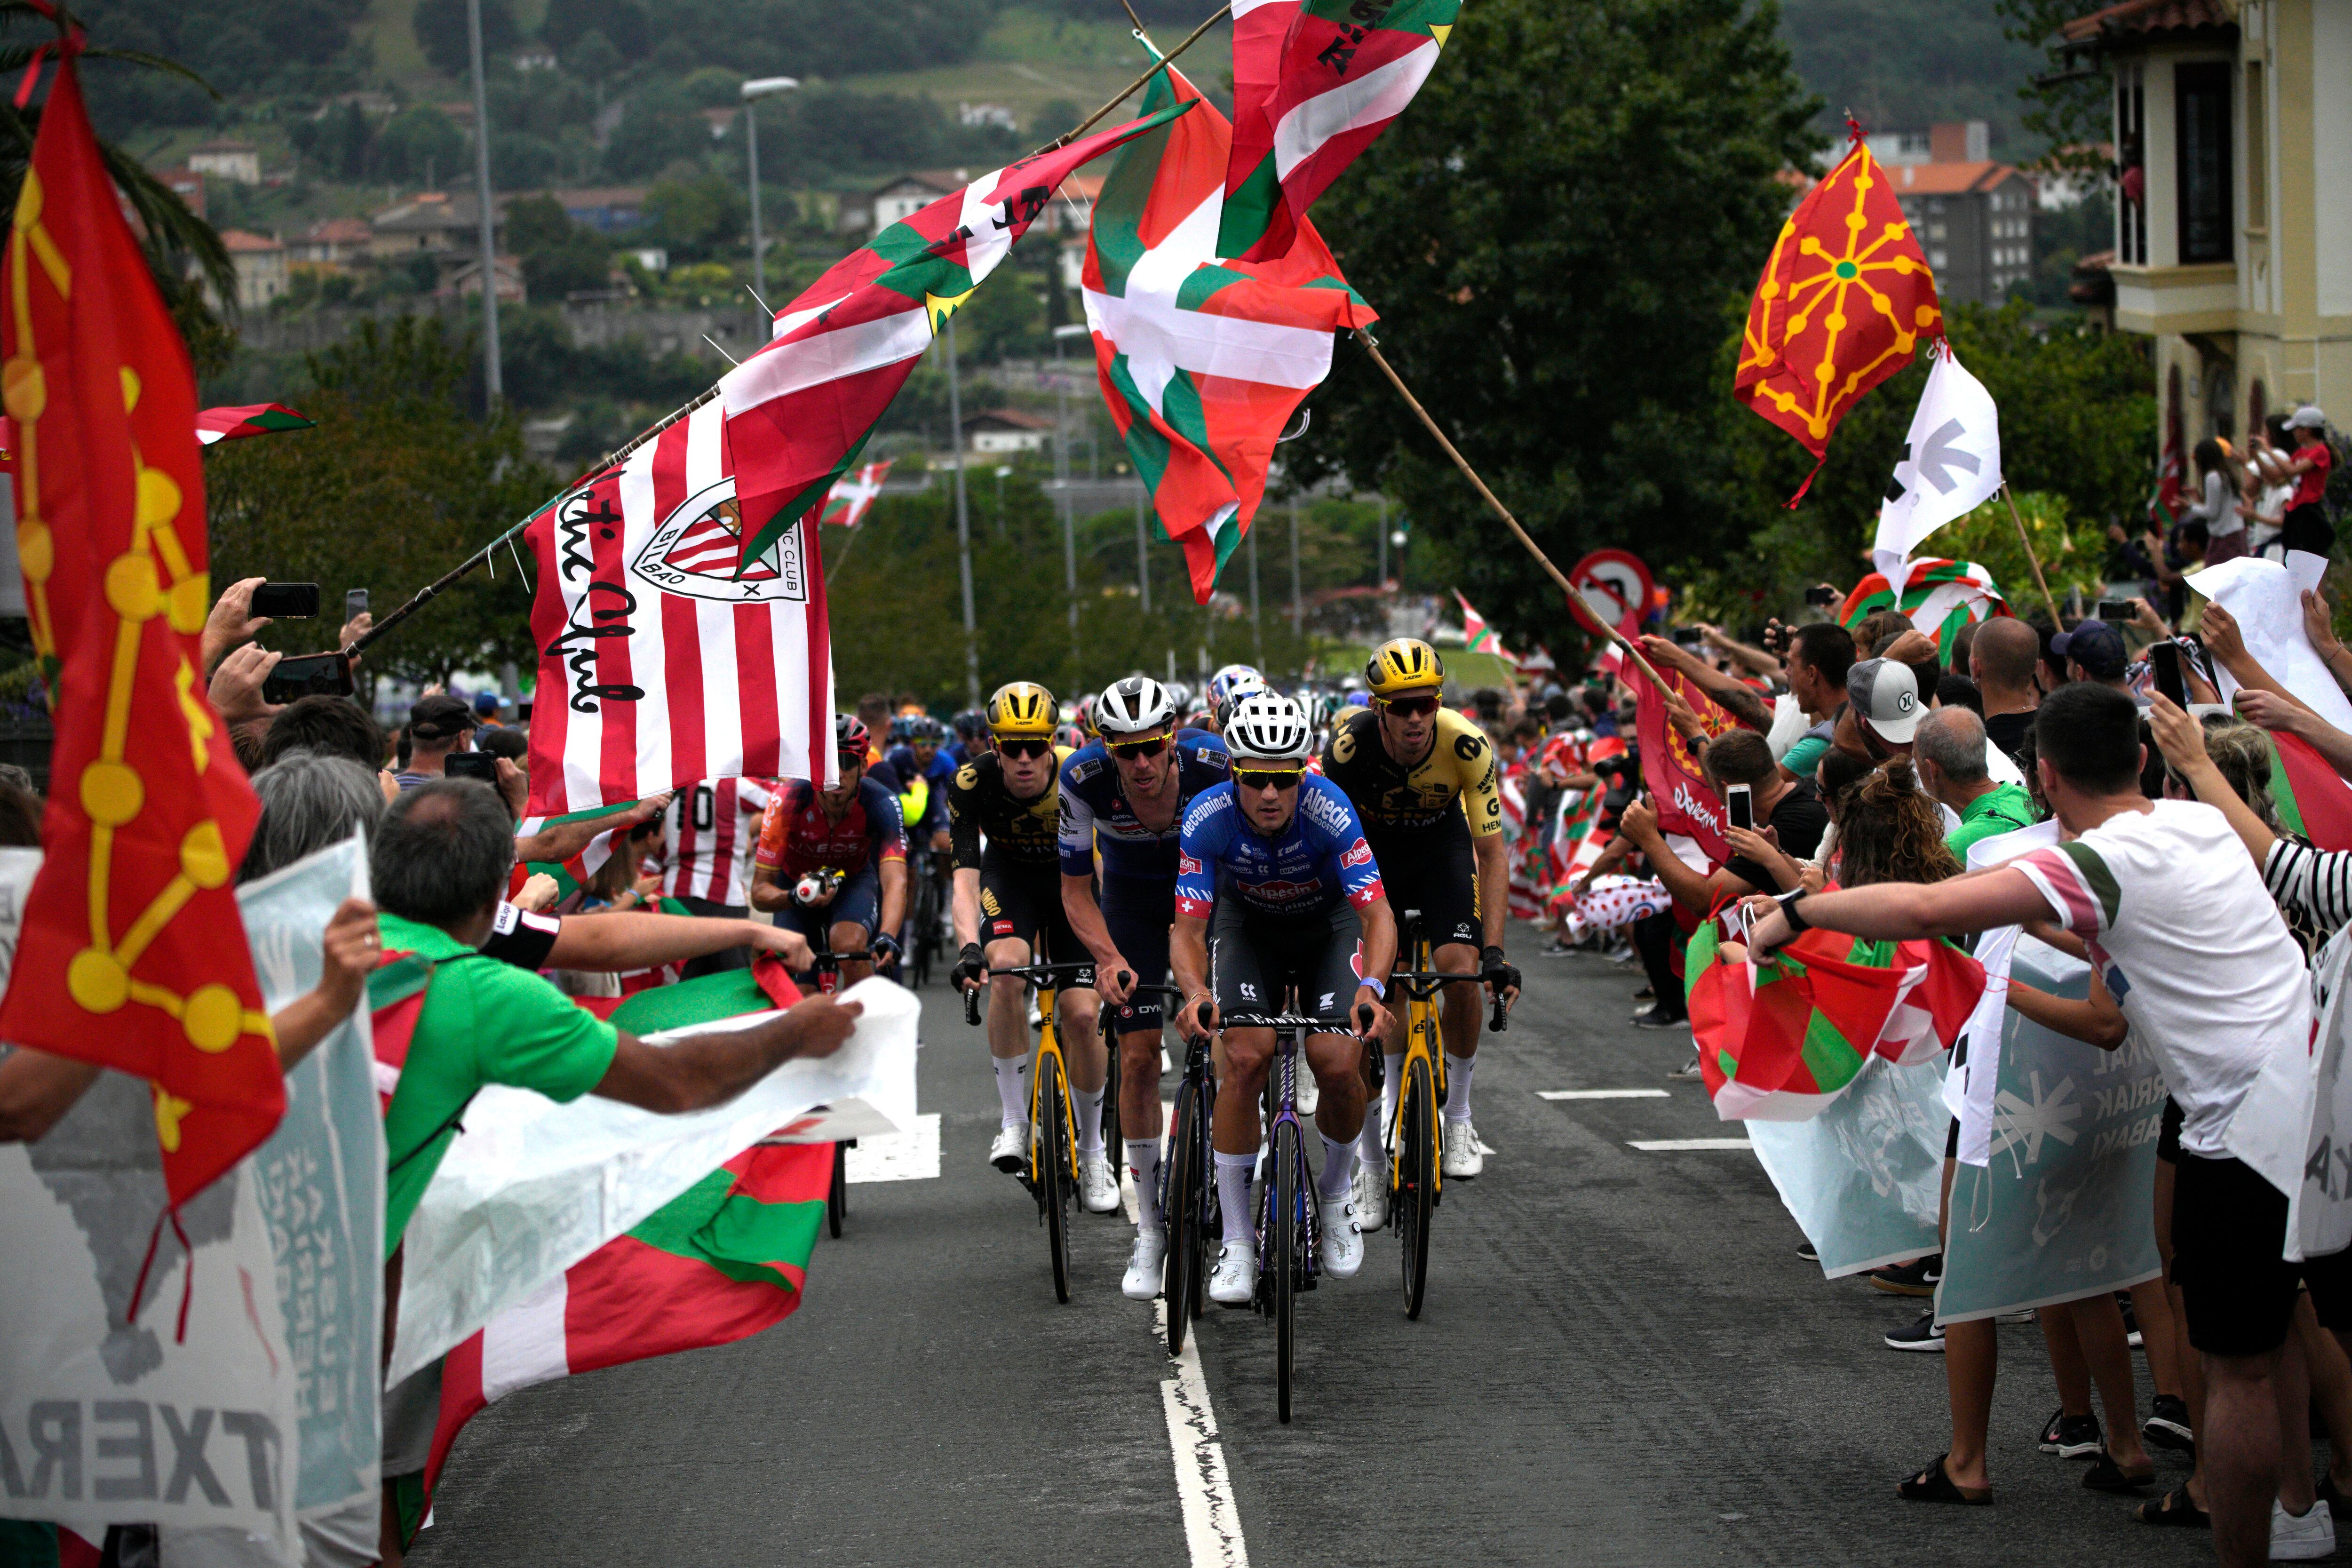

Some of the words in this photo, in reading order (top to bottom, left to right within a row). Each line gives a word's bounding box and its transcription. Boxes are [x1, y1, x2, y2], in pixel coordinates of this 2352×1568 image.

[785, 550, 797, 591] CLUB
[1209, 750, 1227, 760] SAFETY
[1183, 792, 1233, 838] deceuninck
[1301, 787, 1351, 833] Alpecin
[1314, 816, 1341, 838] BOOSTER
[1482, 819, 1502, 832] HEM
[1138, 1004, 1162, 1014] DYK
